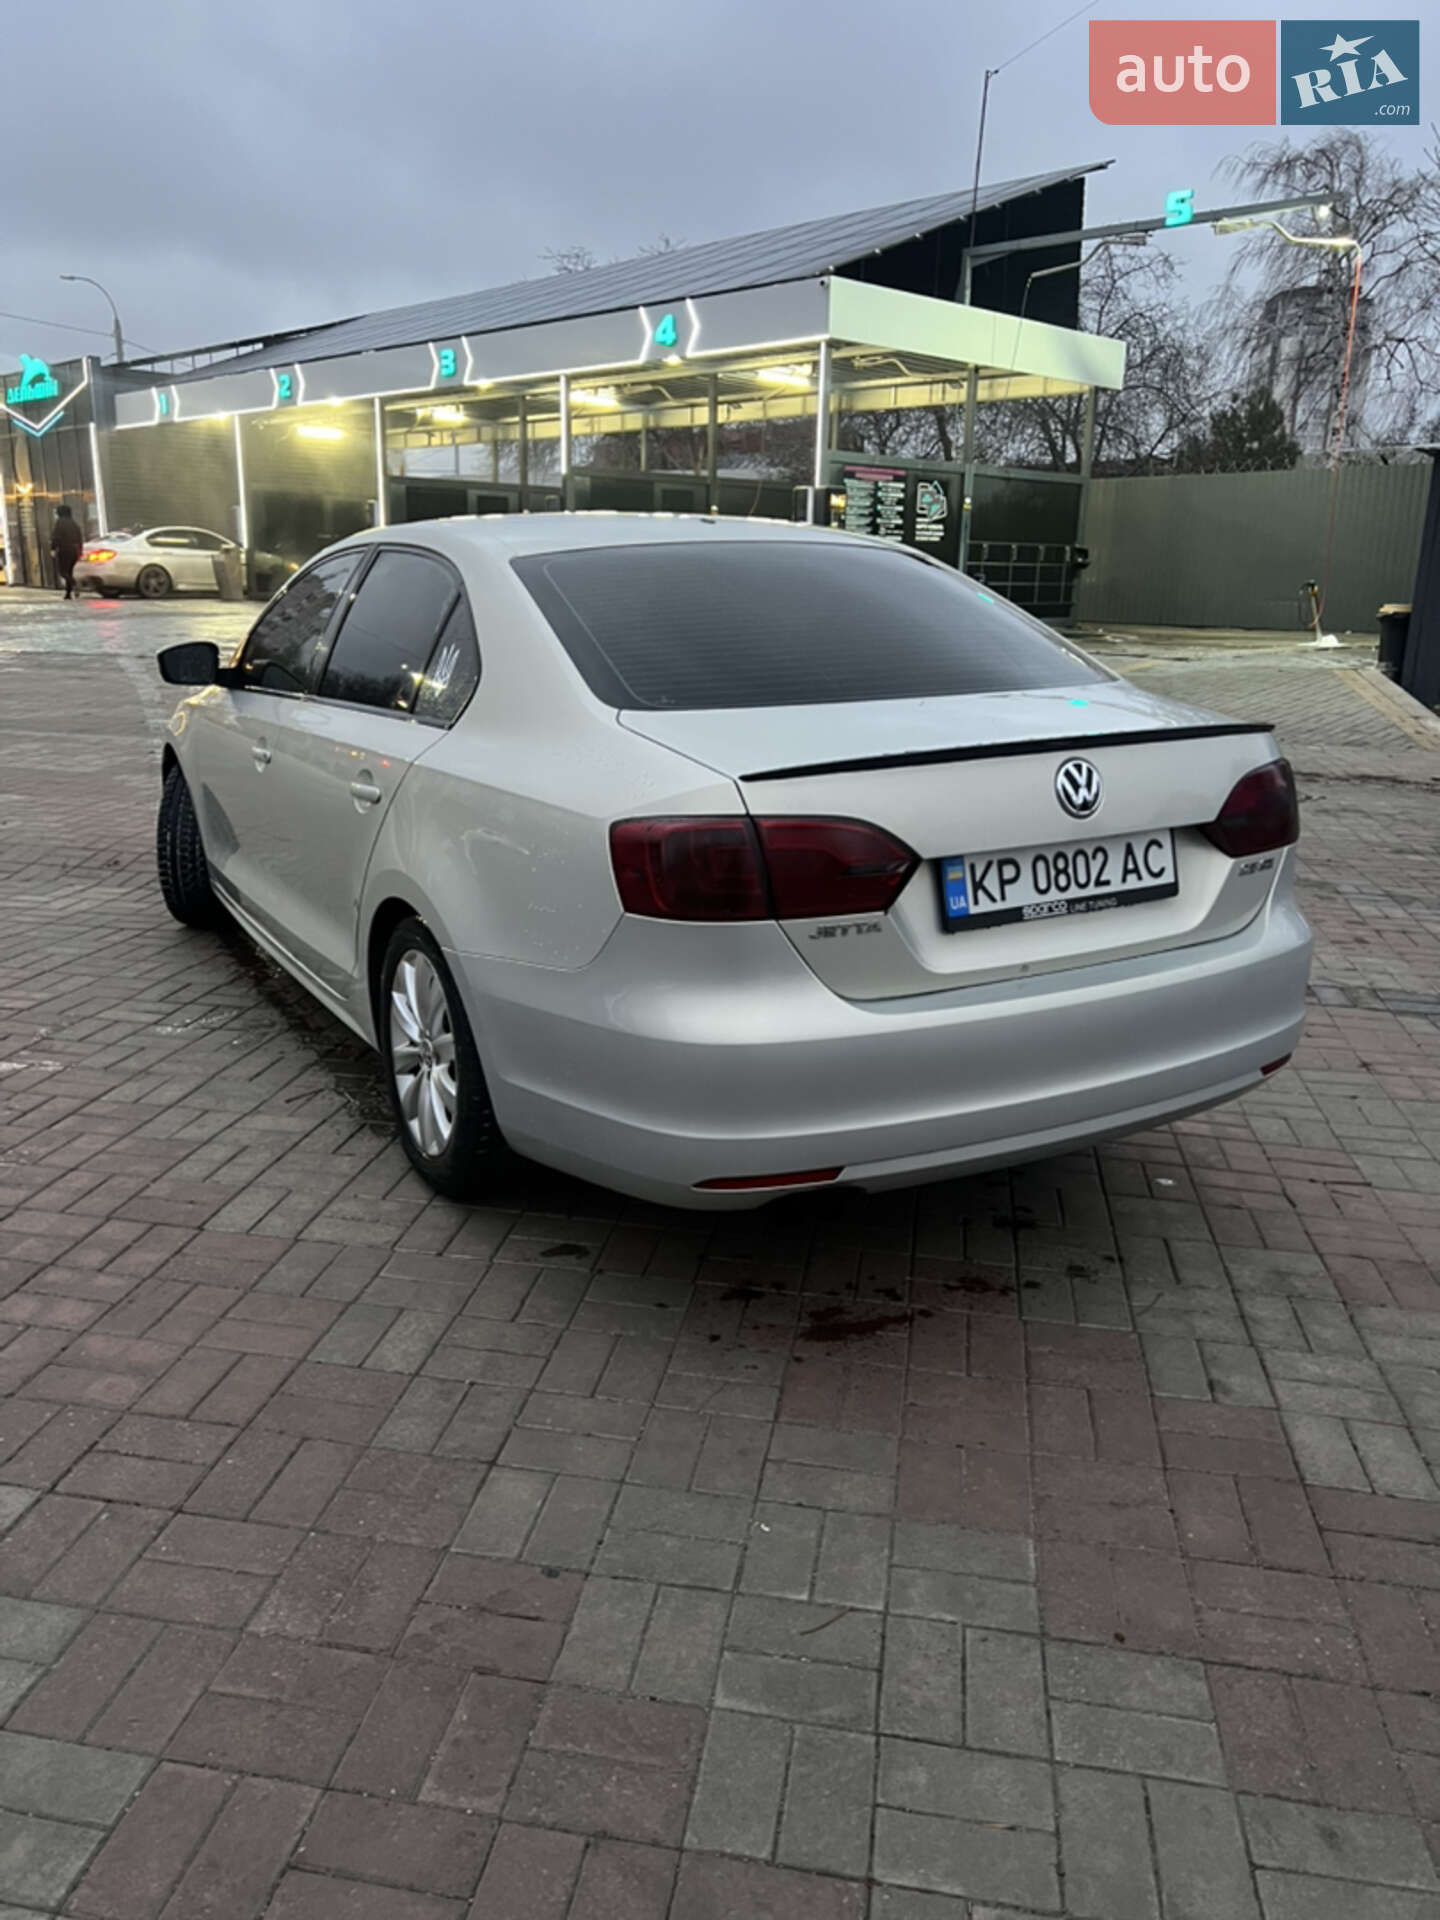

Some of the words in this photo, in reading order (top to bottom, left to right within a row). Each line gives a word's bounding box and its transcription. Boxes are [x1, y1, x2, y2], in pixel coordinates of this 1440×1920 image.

[1164, 189, 1194, 228] 5
[654, 313, 677, 346] 4
[440, 349, 456, 378] 3
[279, 374, 293, 399] 2
[158, 393, 169, 416] 1
[969, 857, 1022, 906] KP
[1031, 846, 1112, 896] 0802
[1121, 838, 1167, 885] AC
[950, 895, 968, 911] UA
[808, 922, 883, 940] JETTA
